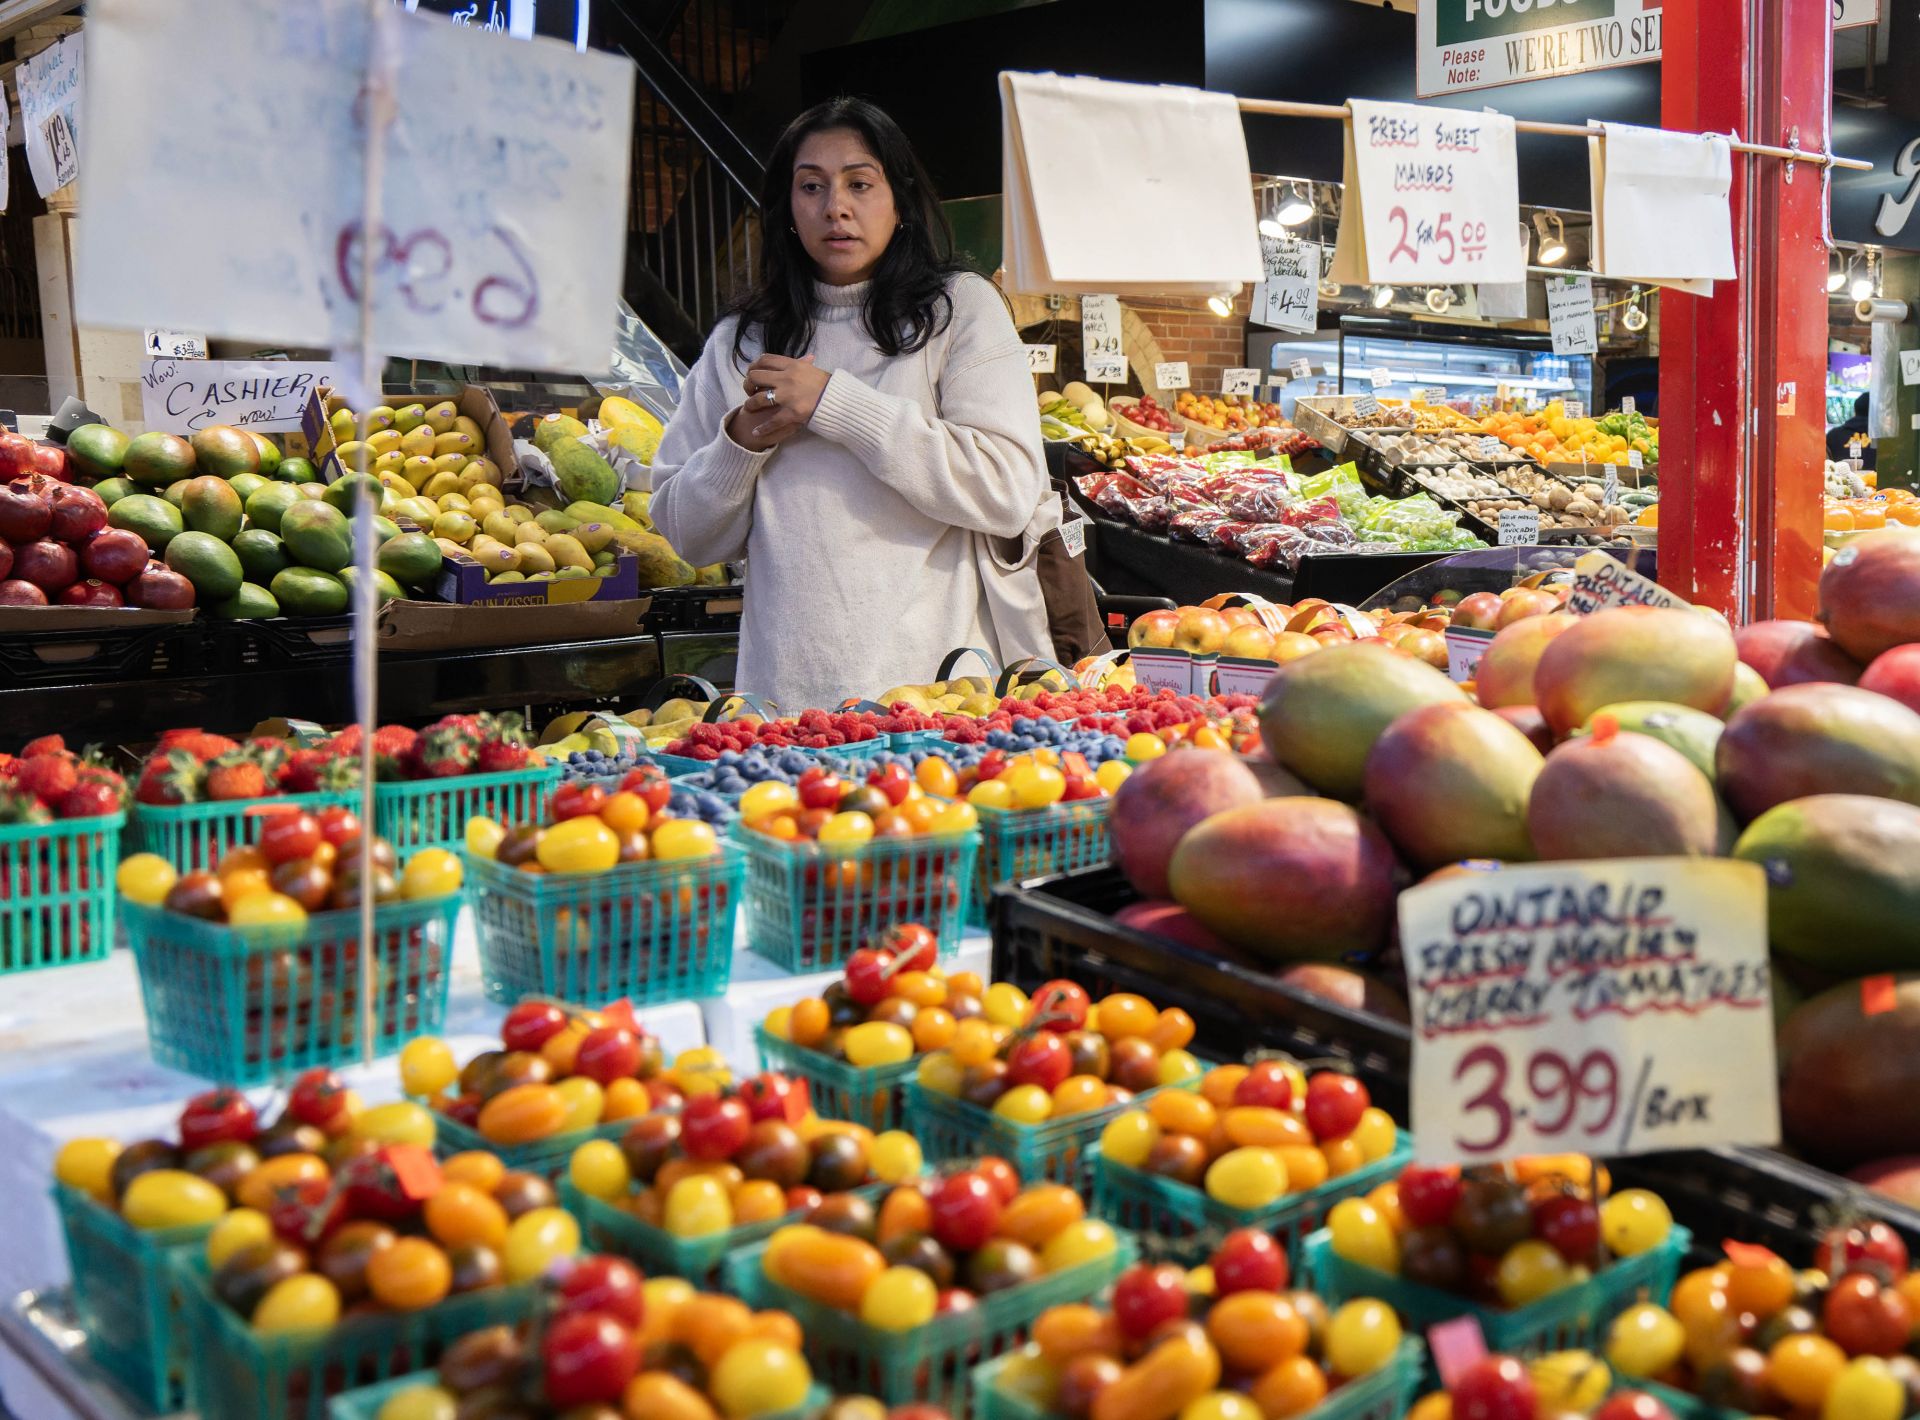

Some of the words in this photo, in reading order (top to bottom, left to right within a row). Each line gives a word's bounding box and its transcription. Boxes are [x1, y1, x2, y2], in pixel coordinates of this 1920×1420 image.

[1465, 0, 1577, 22] FOO
[1442, 49, 1485, 67] Please
[1505, 31, 1569, 76] WE'RE
[1576, 21, 1623, 64] TWO
[1447, 68, 1480, 85] Note:
[1369, 115, 1419, 142] FRESH
[1435, 122, 1480, 148] SWEET
[1395, 162, 1453, 186] MANGOS
[1594, 564, 1671, 608] ONTARIO
[1451, 884, 1665, 937] ONTARIO
